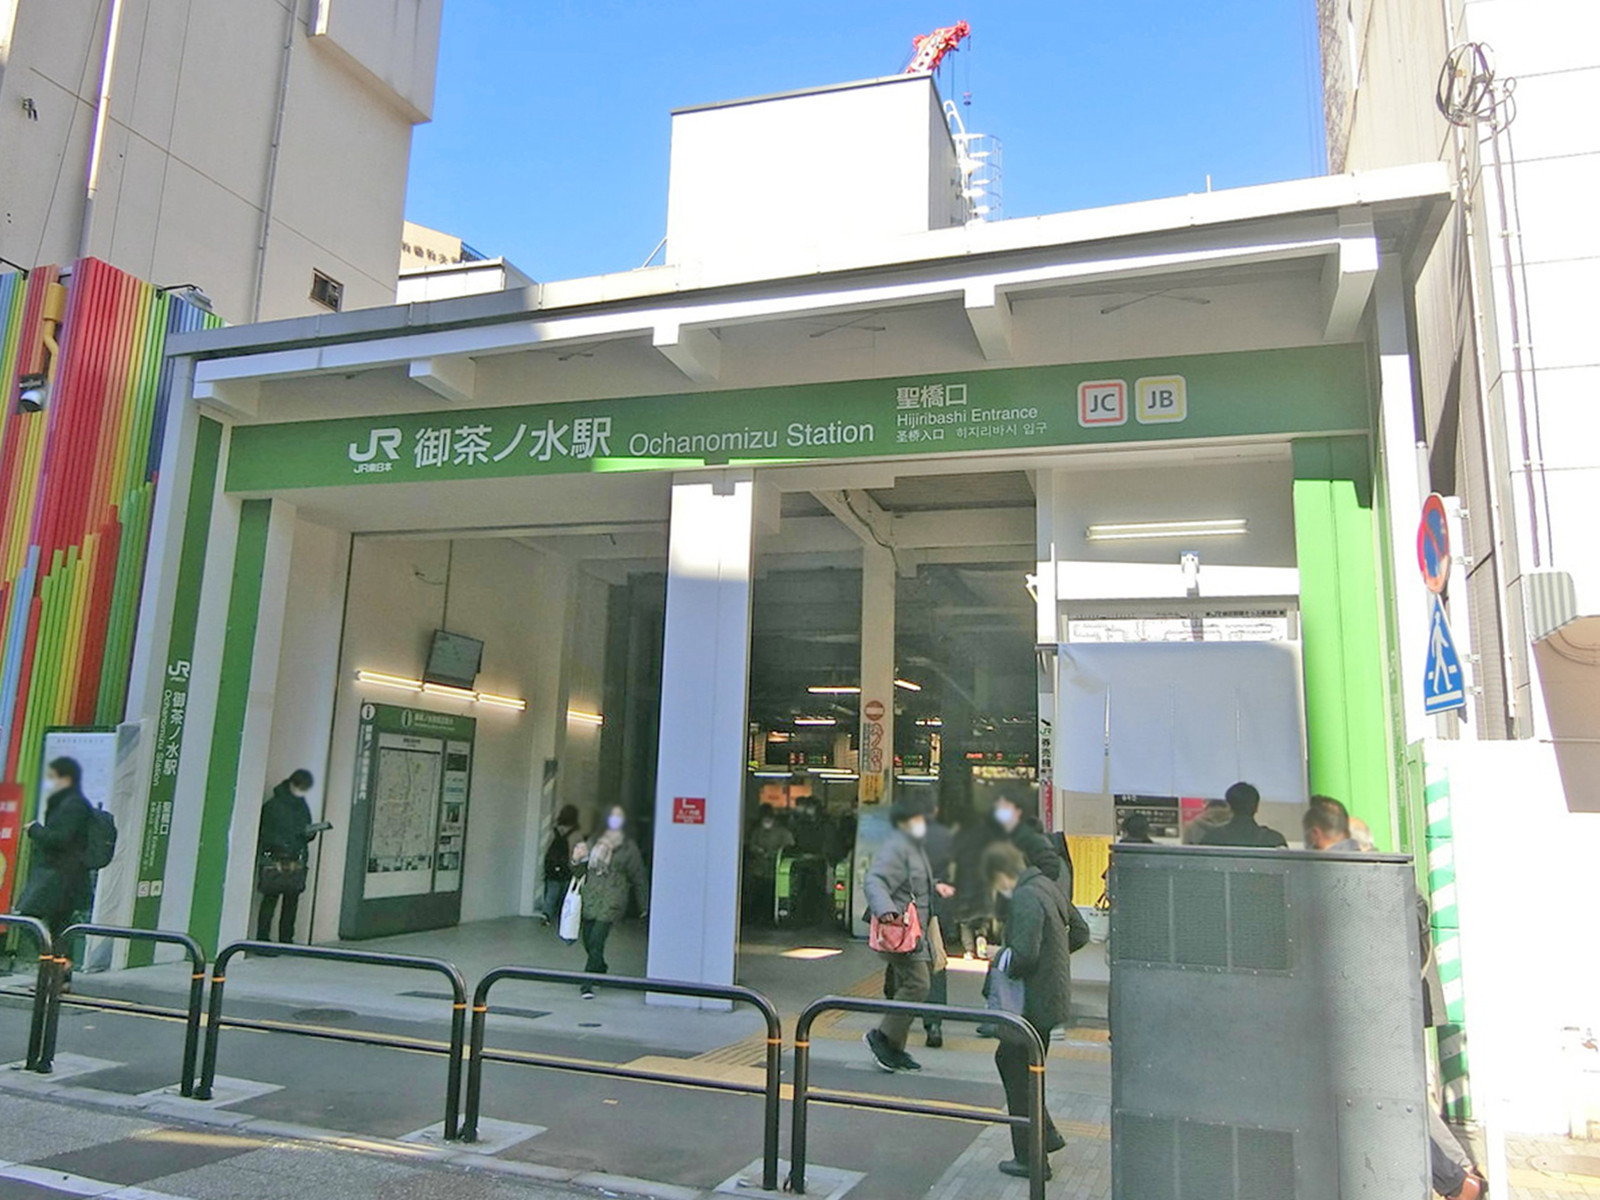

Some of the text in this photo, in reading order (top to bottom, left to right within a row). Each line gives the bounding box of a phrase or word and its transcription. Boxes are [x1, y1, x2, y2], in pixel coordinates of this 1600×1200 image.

[896, 383, 968, 410] 聖橋口
[1089, 393, 1117, 413] JC
[1147, 389, 1175, 409] JB
[896, 406, 1039, 430] Hijiribashi Entrance
[1023, 422, 1048, 435] 입구
[348, 427, 403, 462] JR
[413, 416, 612, 468] 御茶ノ水駅
[629, 420, 875, 456] Ochanomizu Station
[168, 660, 190, 678] JR
[162, 691, 187, 776] 御茶ノ水駅
